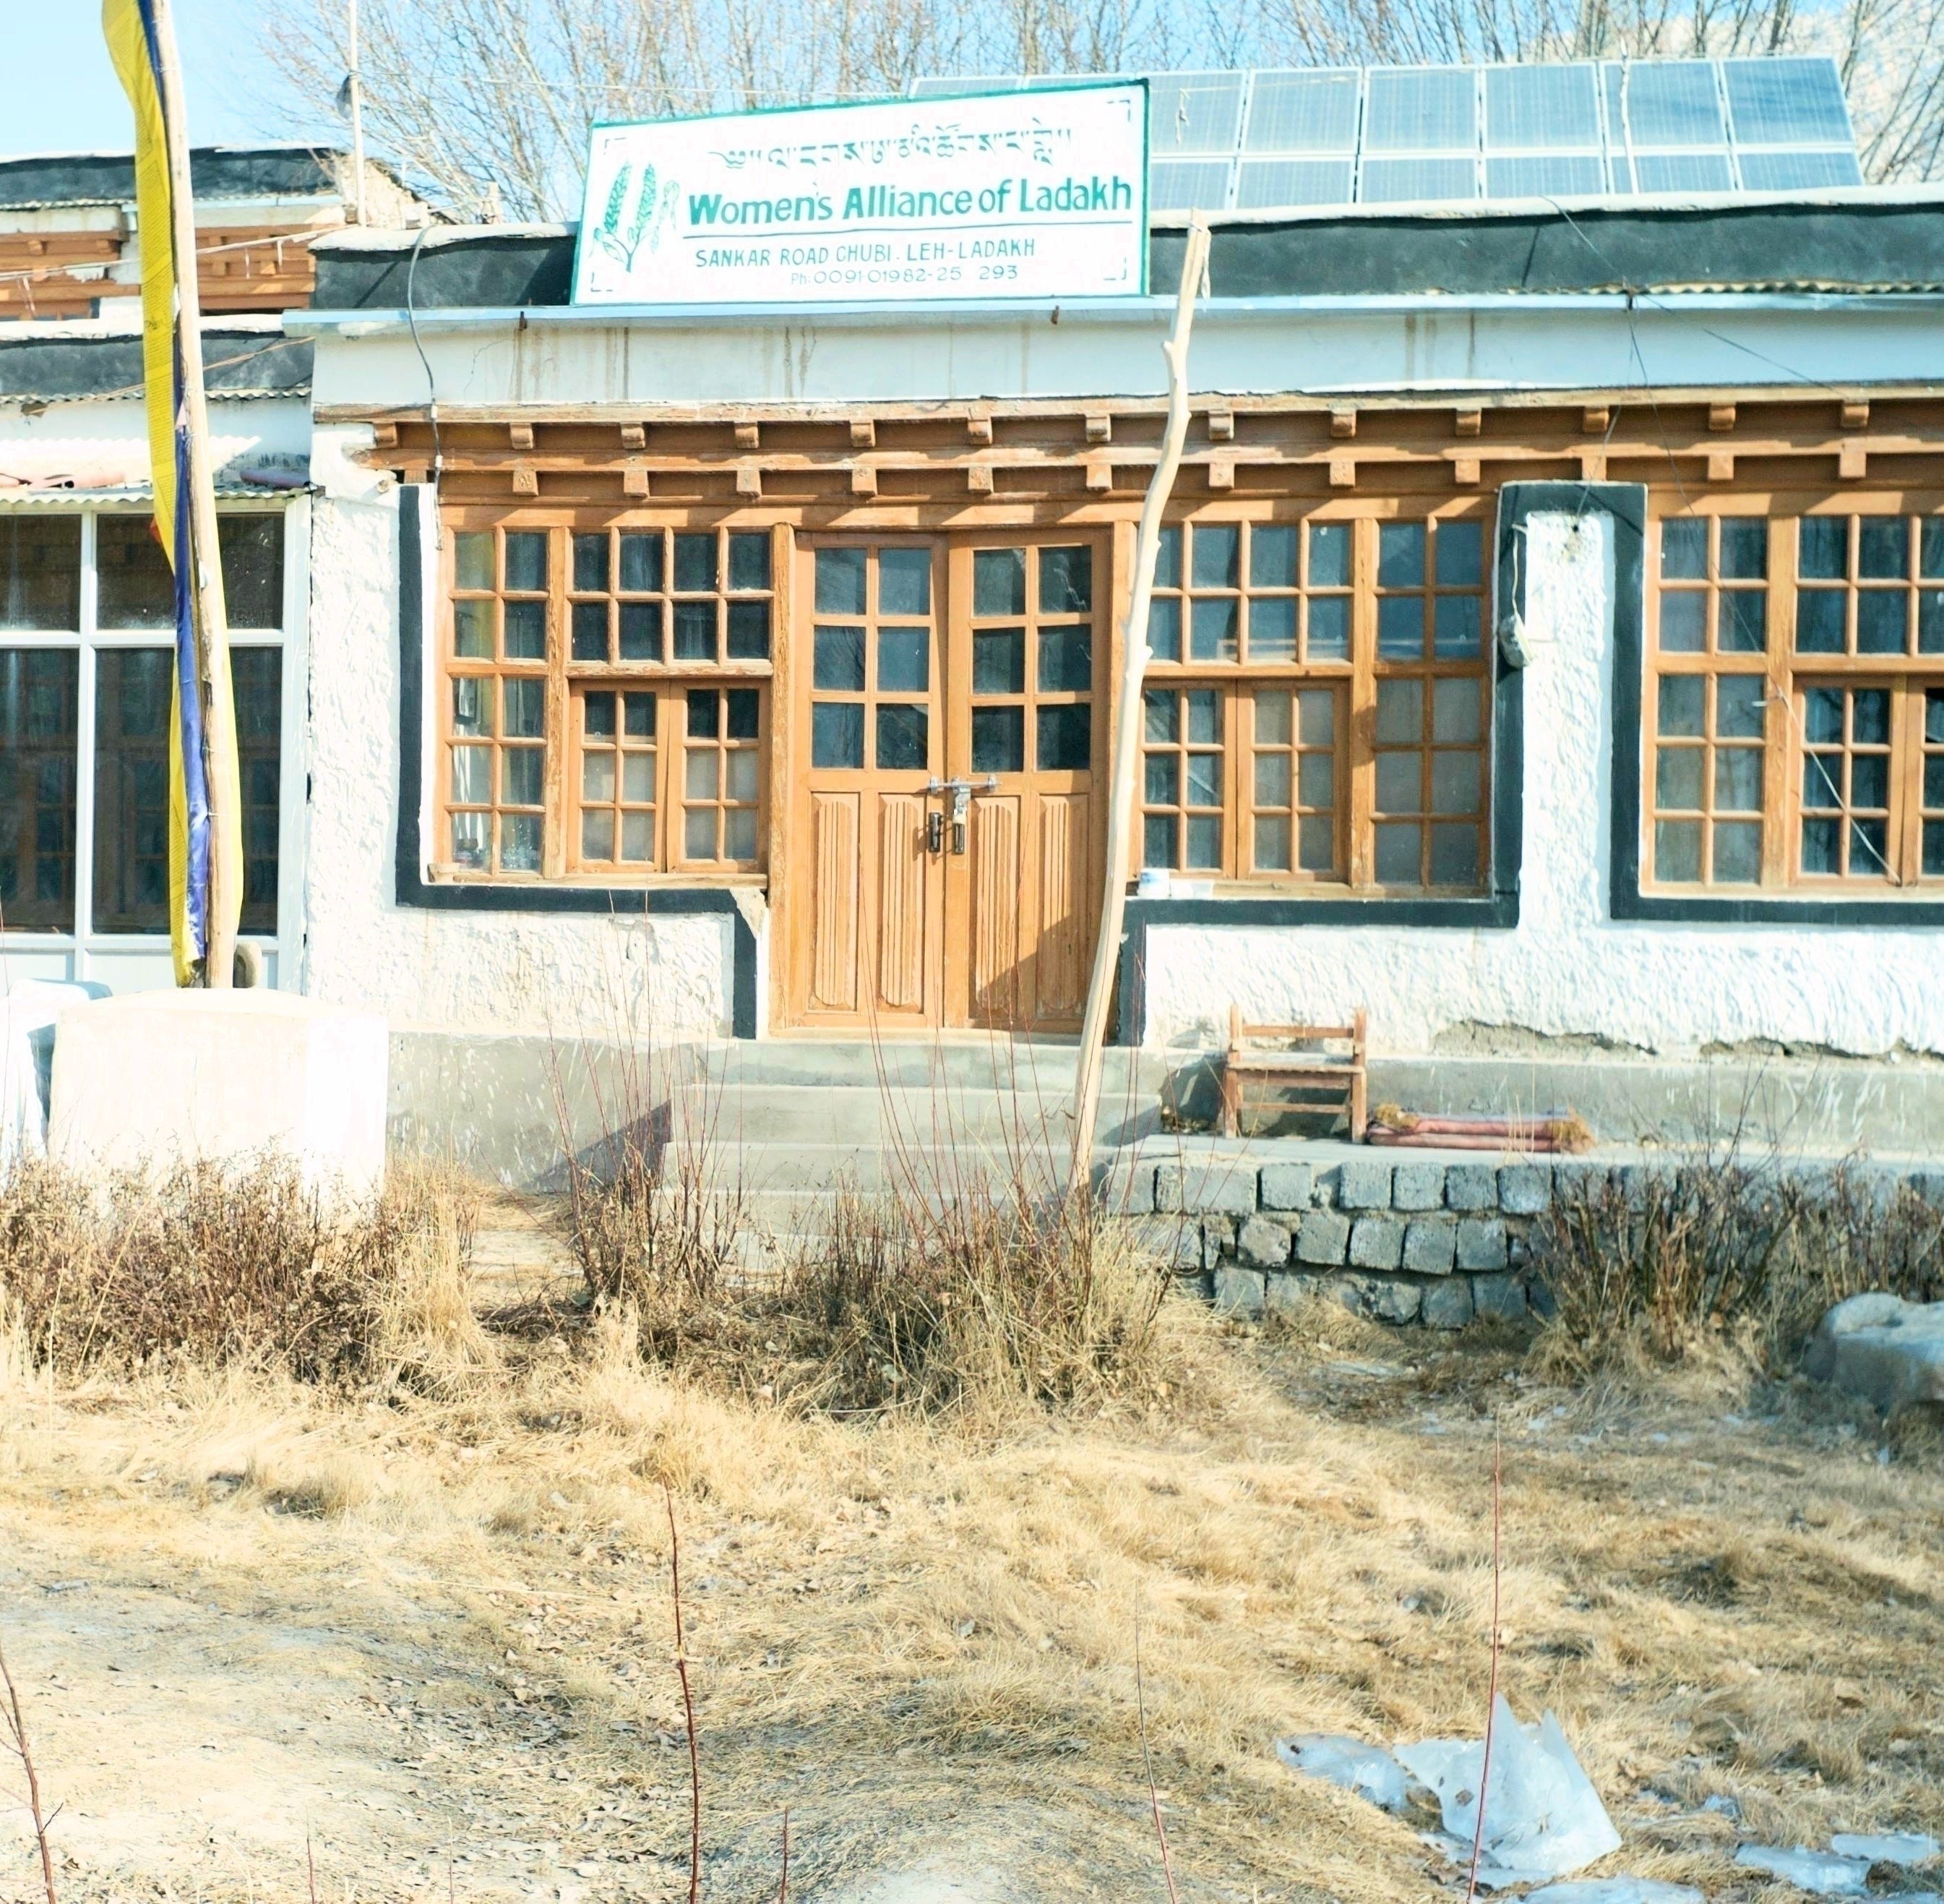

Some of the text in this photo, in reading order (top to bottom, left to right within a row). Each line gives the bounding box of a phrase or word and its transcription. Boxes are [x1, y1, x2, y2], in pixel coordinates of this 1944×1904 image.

[688, 175, 1132, 226] Women's Alliance of Ladakh
[695, 249, 771, 267] SANKAR
[780, 246, 829, 266] ROAD
[906, 238, 1036, 262] LEH-LADAKH
[979, 265, 1019, 281] 293
